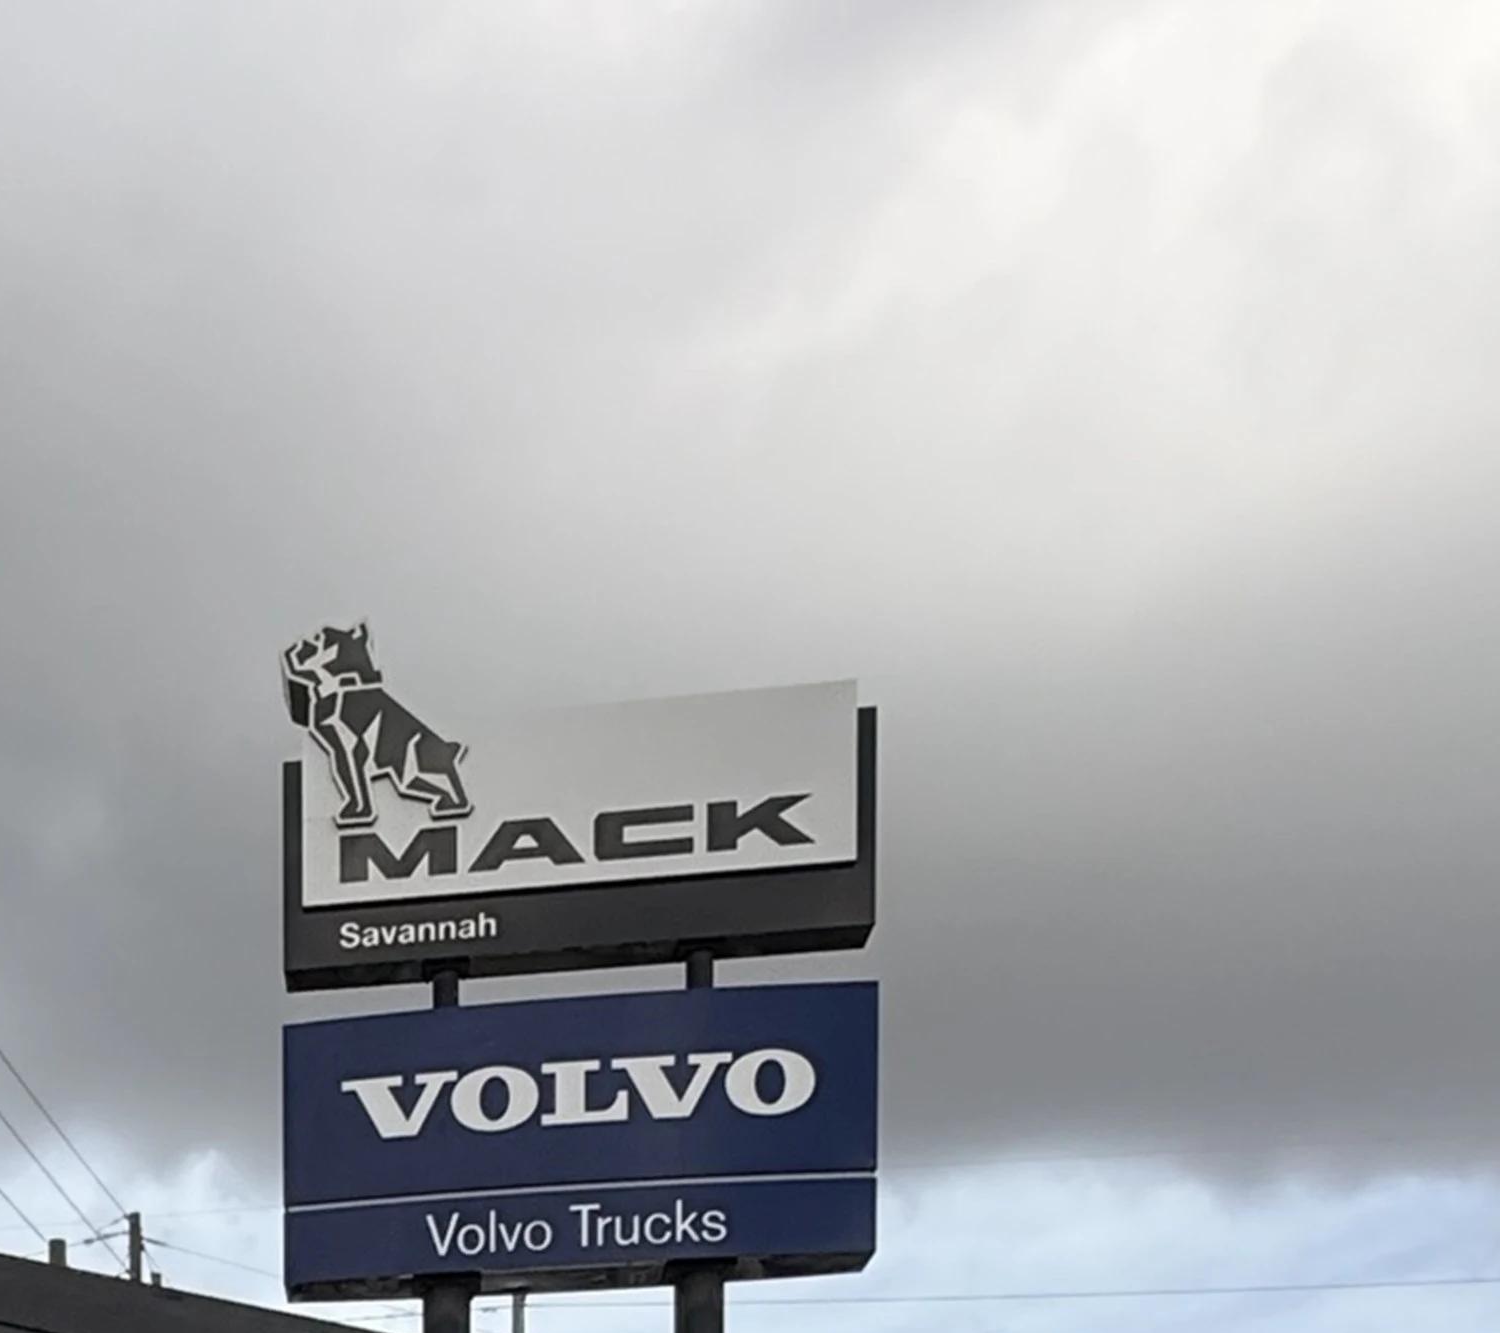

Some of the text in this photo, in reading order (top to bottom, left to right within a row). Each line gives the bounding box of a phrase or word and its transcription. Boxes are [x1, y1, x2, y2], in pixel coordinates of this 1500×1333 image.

[339, 794, 815, 882] MACK
[340, 912, 497, 948] Savannah
[342, 1049, 815, 1138] VOLVO
[426, 1199, 727, 1256] Volvo Trucks
